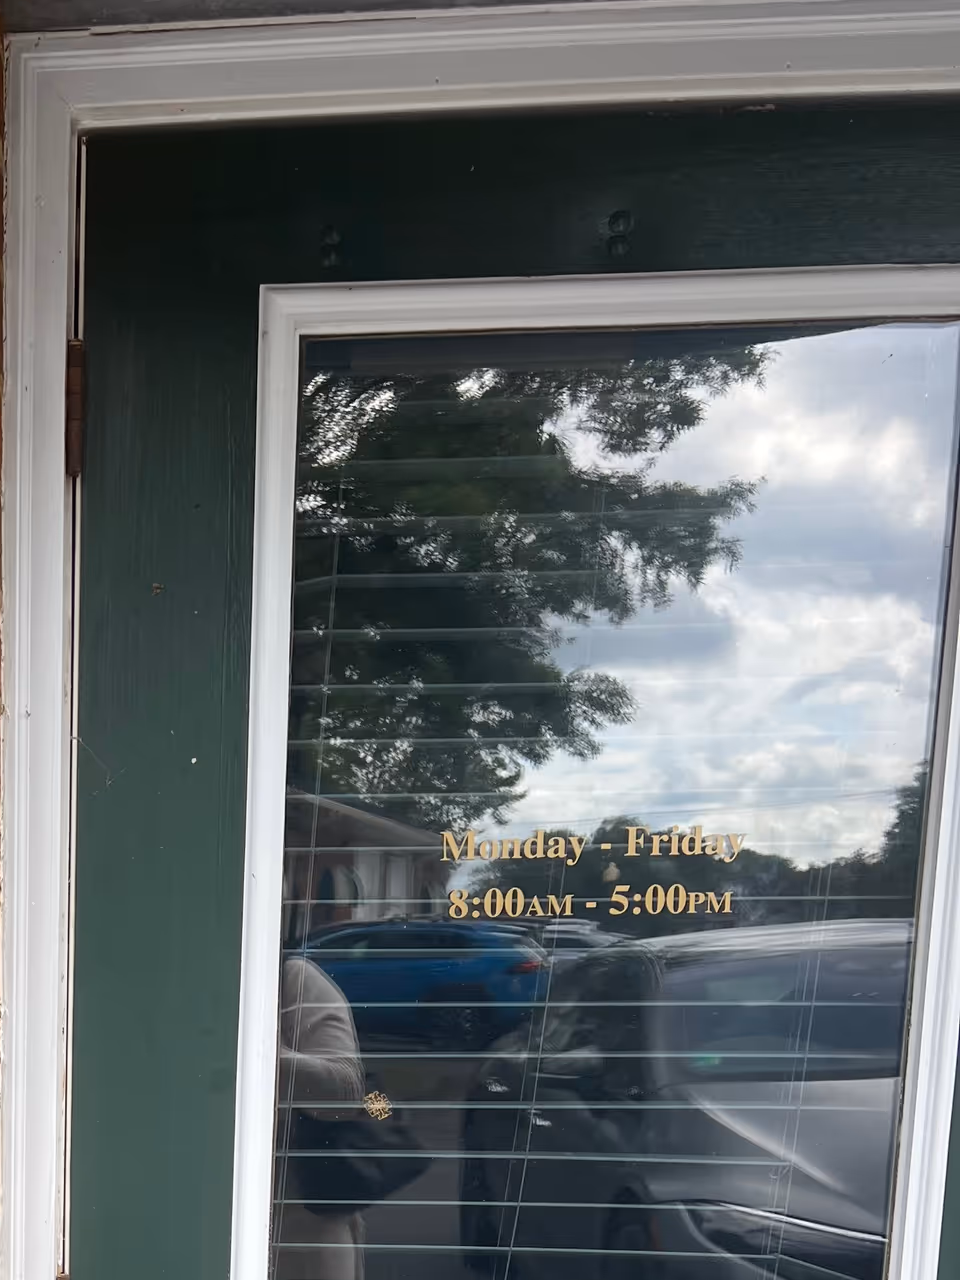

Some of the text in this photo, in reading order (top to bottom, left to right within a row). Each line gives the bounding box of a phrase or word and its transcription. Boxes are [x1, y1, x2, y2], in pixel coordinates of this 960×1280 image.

[440, 825, 745, 866] Monday - Friday
[448, 884, 733, 919] 8:00AM - 5:00PM
